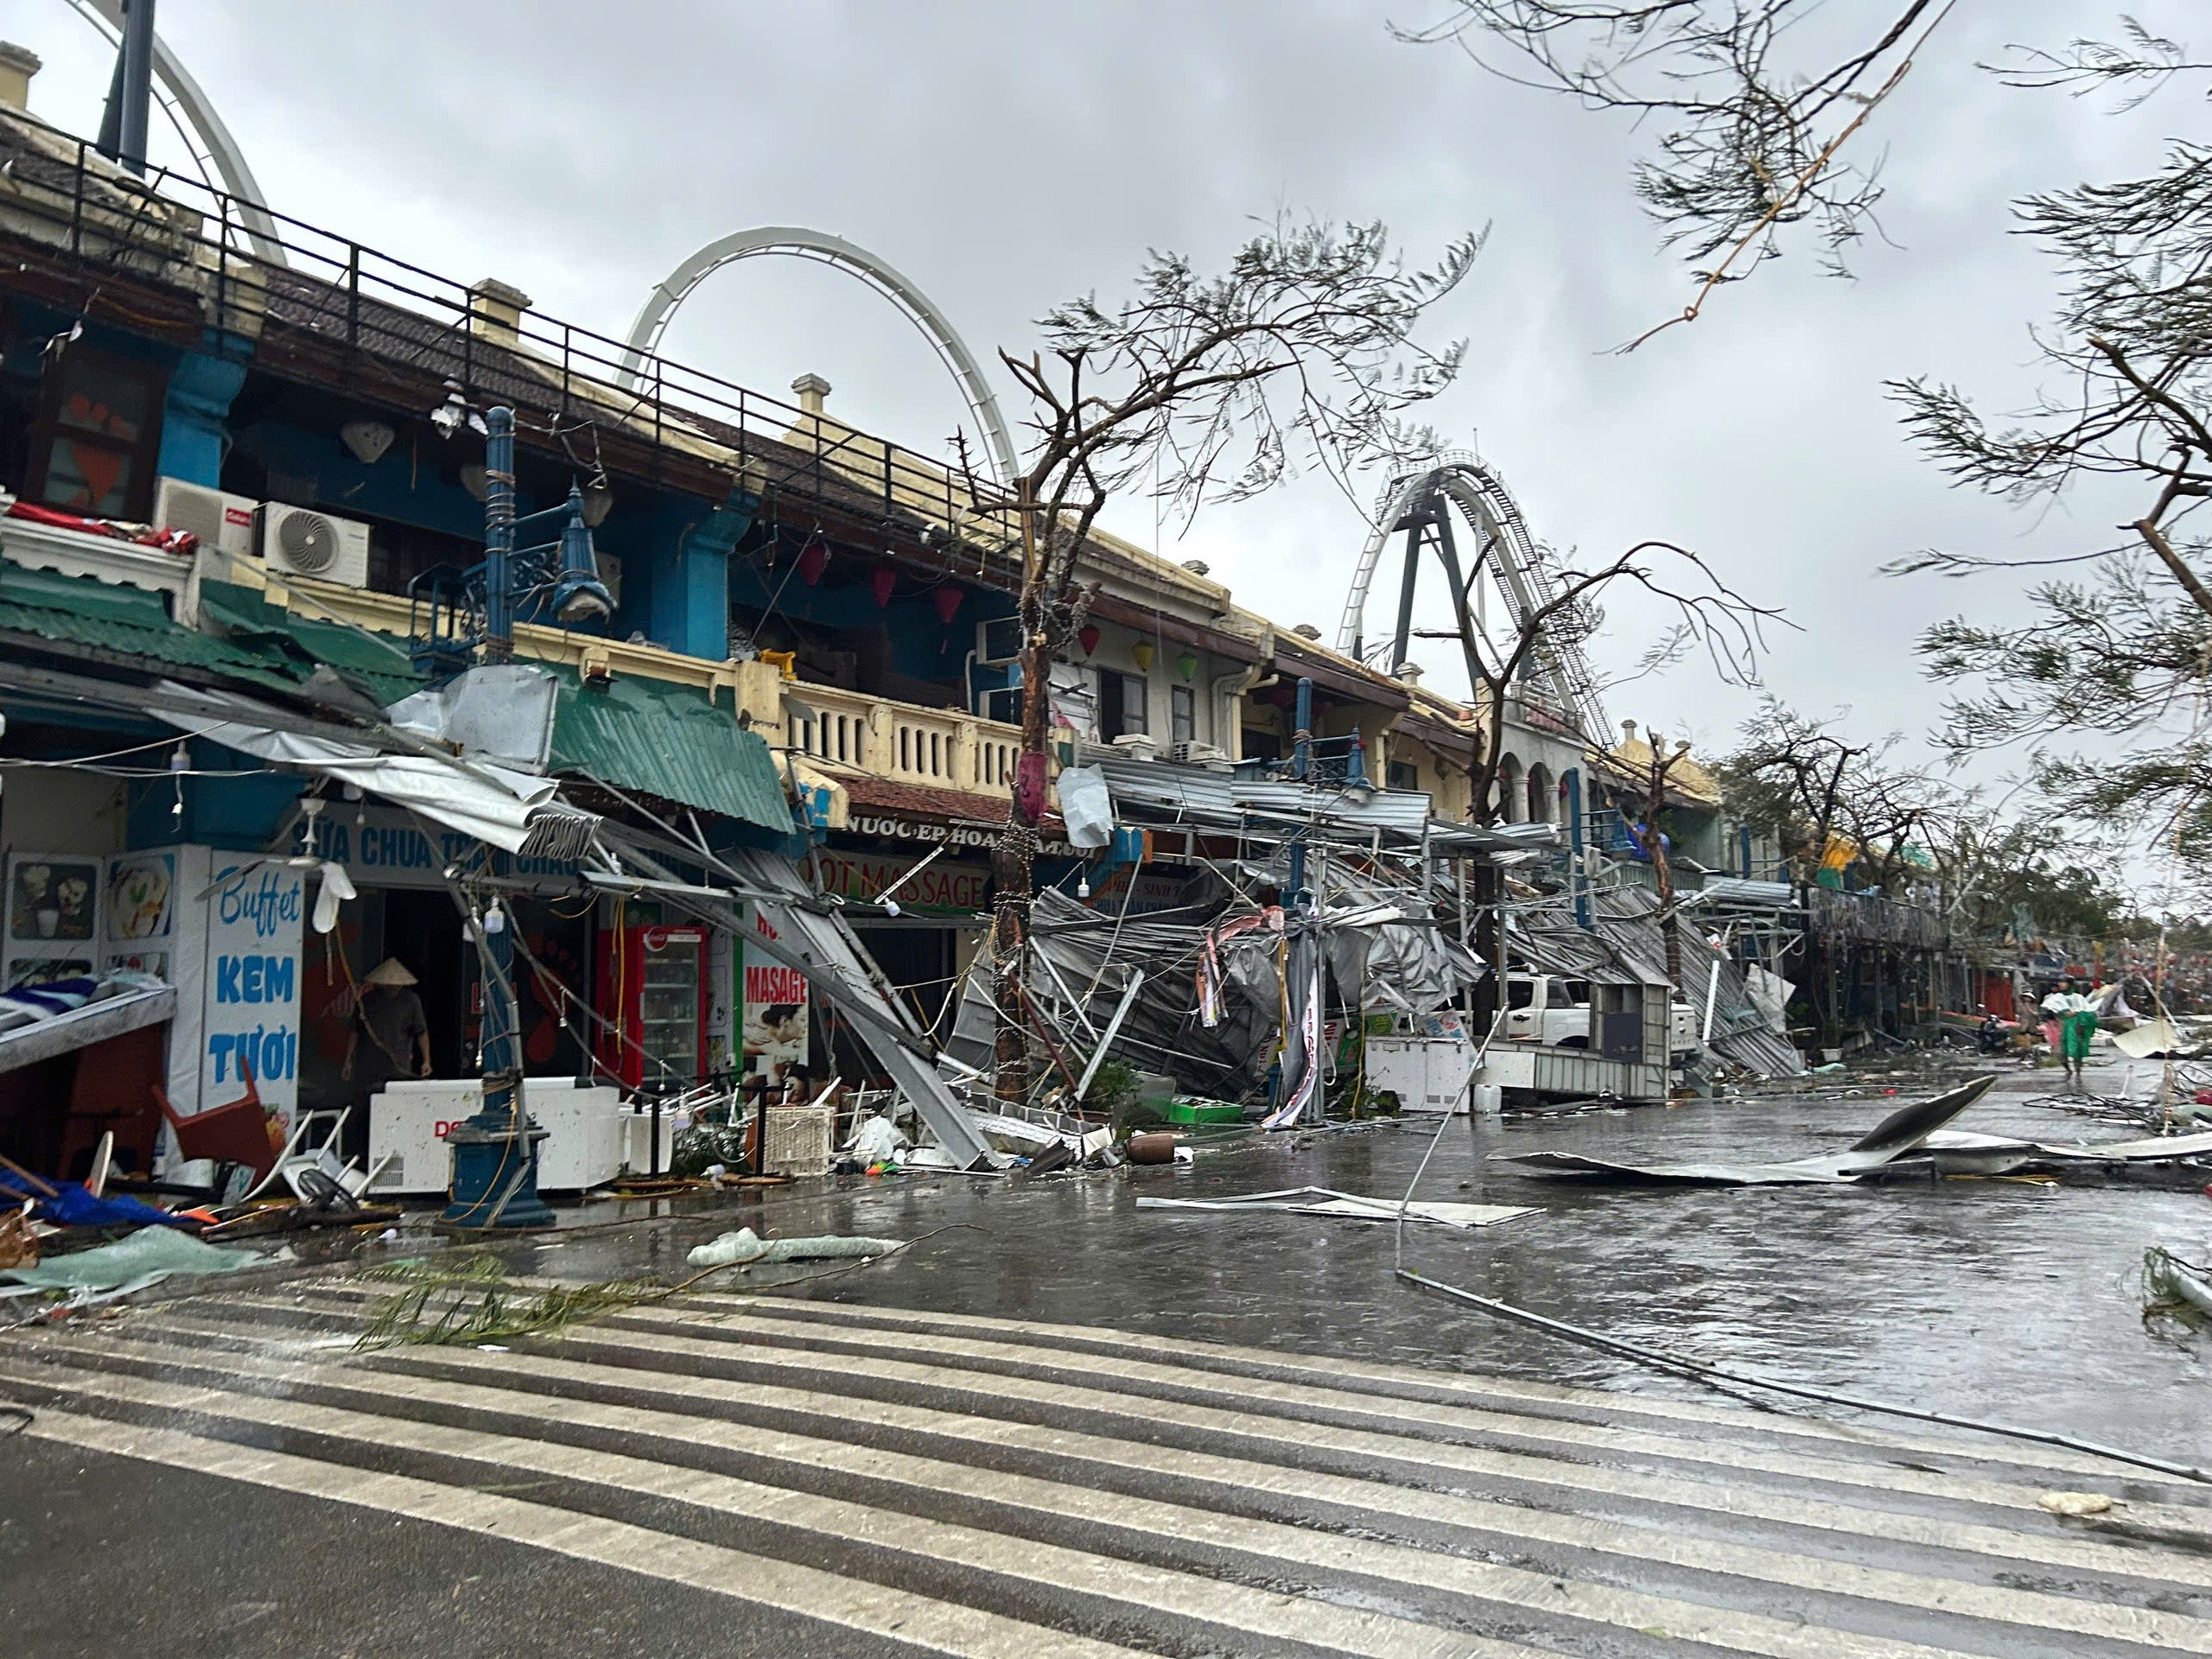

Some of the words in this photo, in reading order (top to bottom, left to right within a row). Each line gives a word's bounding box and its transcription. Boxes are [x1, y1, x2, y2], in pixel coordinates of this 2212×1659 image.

[361, 827, 432, 868] CHUA
[950, 829, 998, 849] HOA
[215, 865, 301, 938] Buffet
[860, 860, 985, 910] MASSAGE
[216, 954, 294, 1004] KEM
[746, 965, 808, 1003] MASAGE
[209, 1023, 296, 1084] TƯƠI
